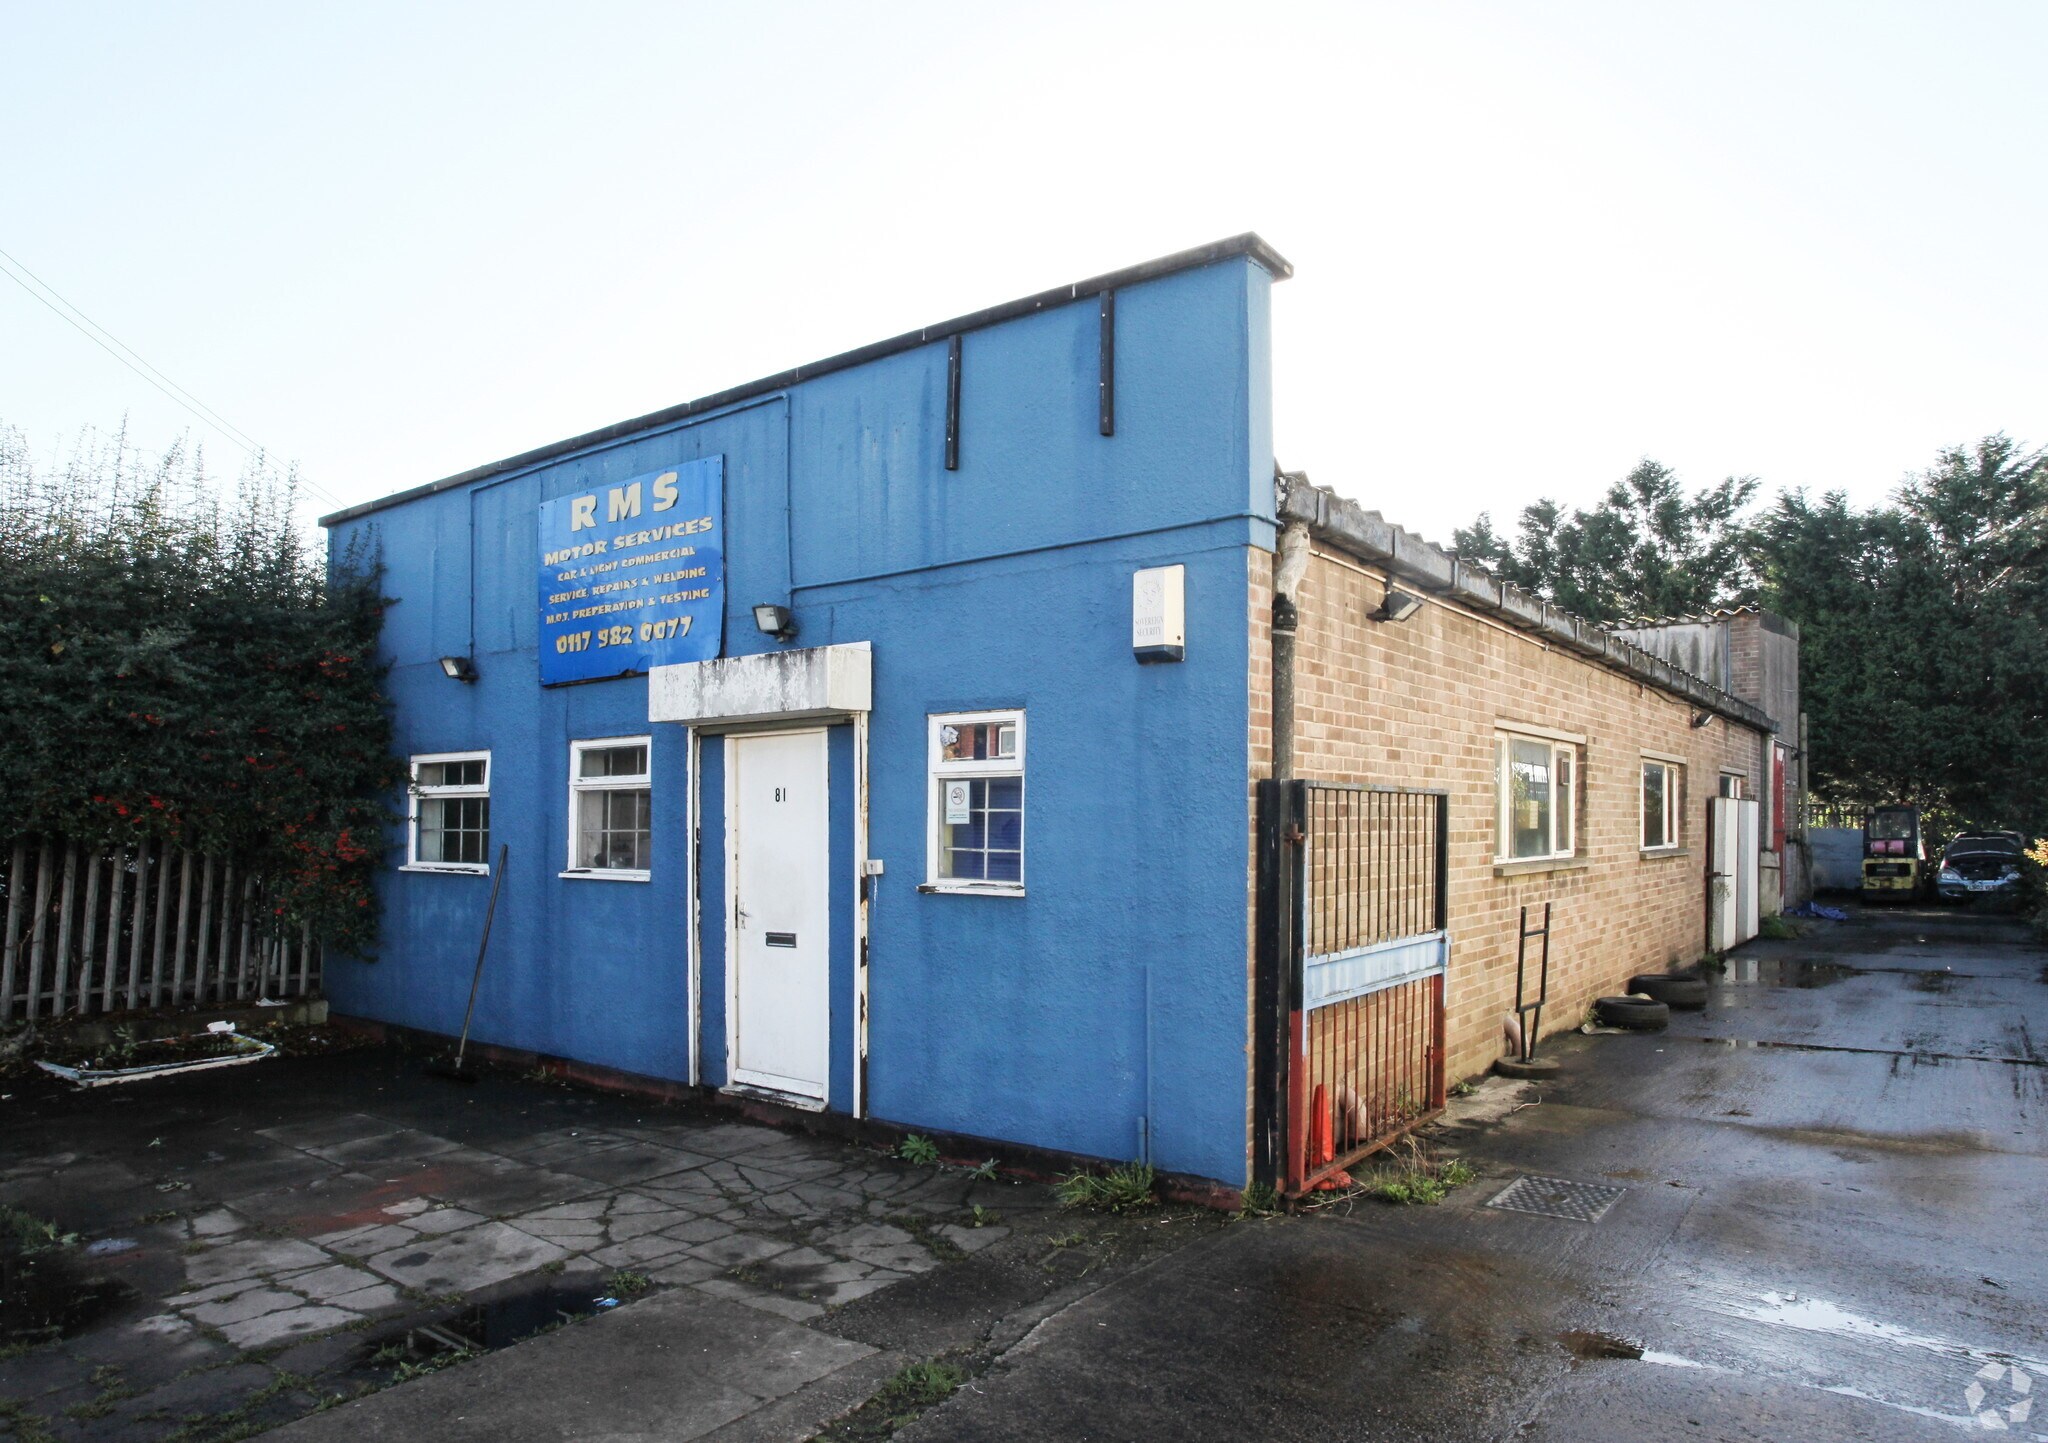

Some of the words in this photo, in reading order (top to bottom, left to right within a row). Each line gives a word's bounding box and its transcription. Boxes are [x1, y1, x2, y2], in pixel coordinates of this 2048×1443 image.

[544, 540, 608, 567] MOTOR
[613, 516, 713, 550] SERVICES
[557, 569, 578, 582] CAR
[580, 567, 587, 577] &
[589, 560, 619, 575] LIGHT
[621, 546, 696, 568] COMMERCIAL
[592, 578, 638, 595] REPAIRS
[641, 577, 649, 586] &
[653, 566, 706, 584] WELDING
[572, 598, 644, 619] PREPERATION
[648, 597, 656, 606] &
[660, 588, 710, 604] TESTING
[556, 630, 592, 655] 0117
[598, 624, 634, 649] 982
[640, 615, 693, 643] 0077
[1136, 626, 1161, 637] SECURITY
[774, 787, 786, 802] 81
